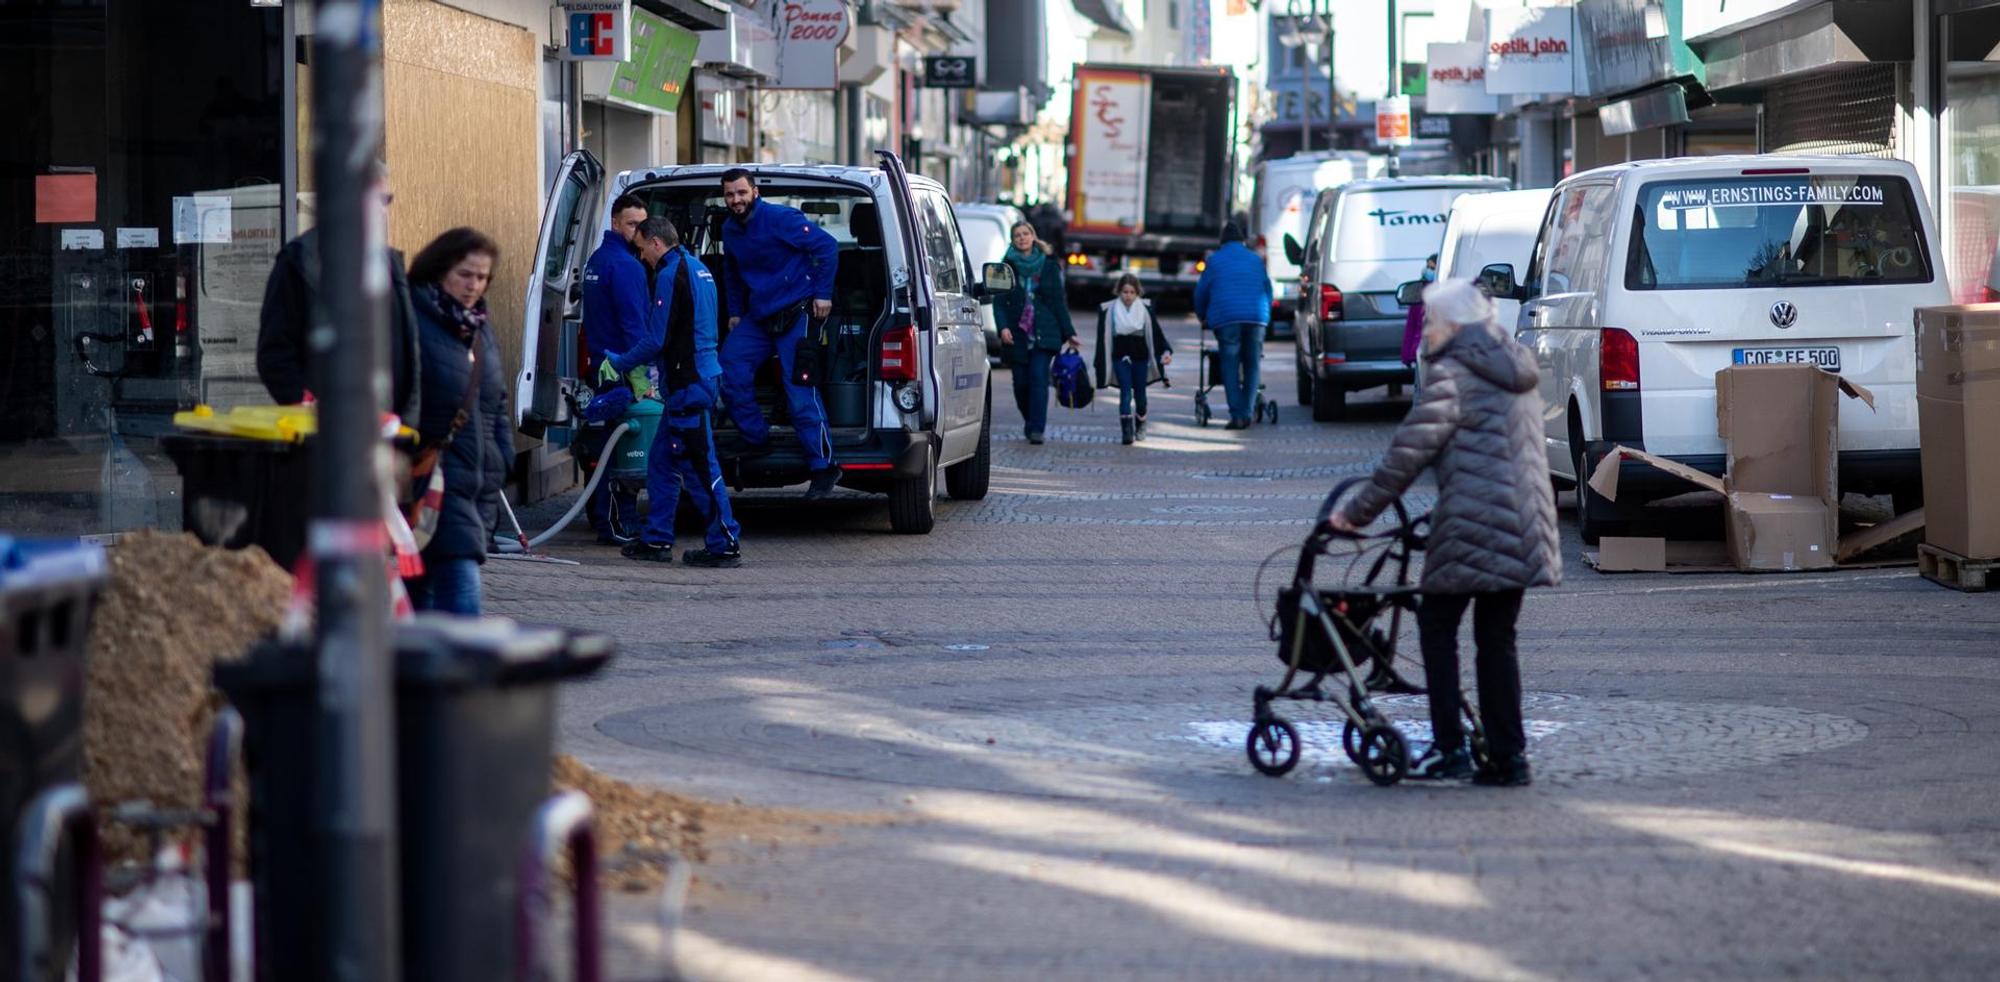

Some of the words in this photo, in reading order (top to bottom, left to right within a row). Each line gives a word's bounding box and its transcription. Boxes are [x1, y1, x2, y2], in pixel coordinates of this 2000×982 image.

[784, 4, 843, 23] Donna
[790, 25, 838, 40] 2000
[1490, 38, 1530, 57] optik
[1669, 186, 1883, 205] WWW.ERNSTINGS-FAMILY.COM
[1641, 327, 1711, 336] TRANSPORTER
[1745, 351, 1773, 365] COE
[1809, 350, 1837, 366] 500
